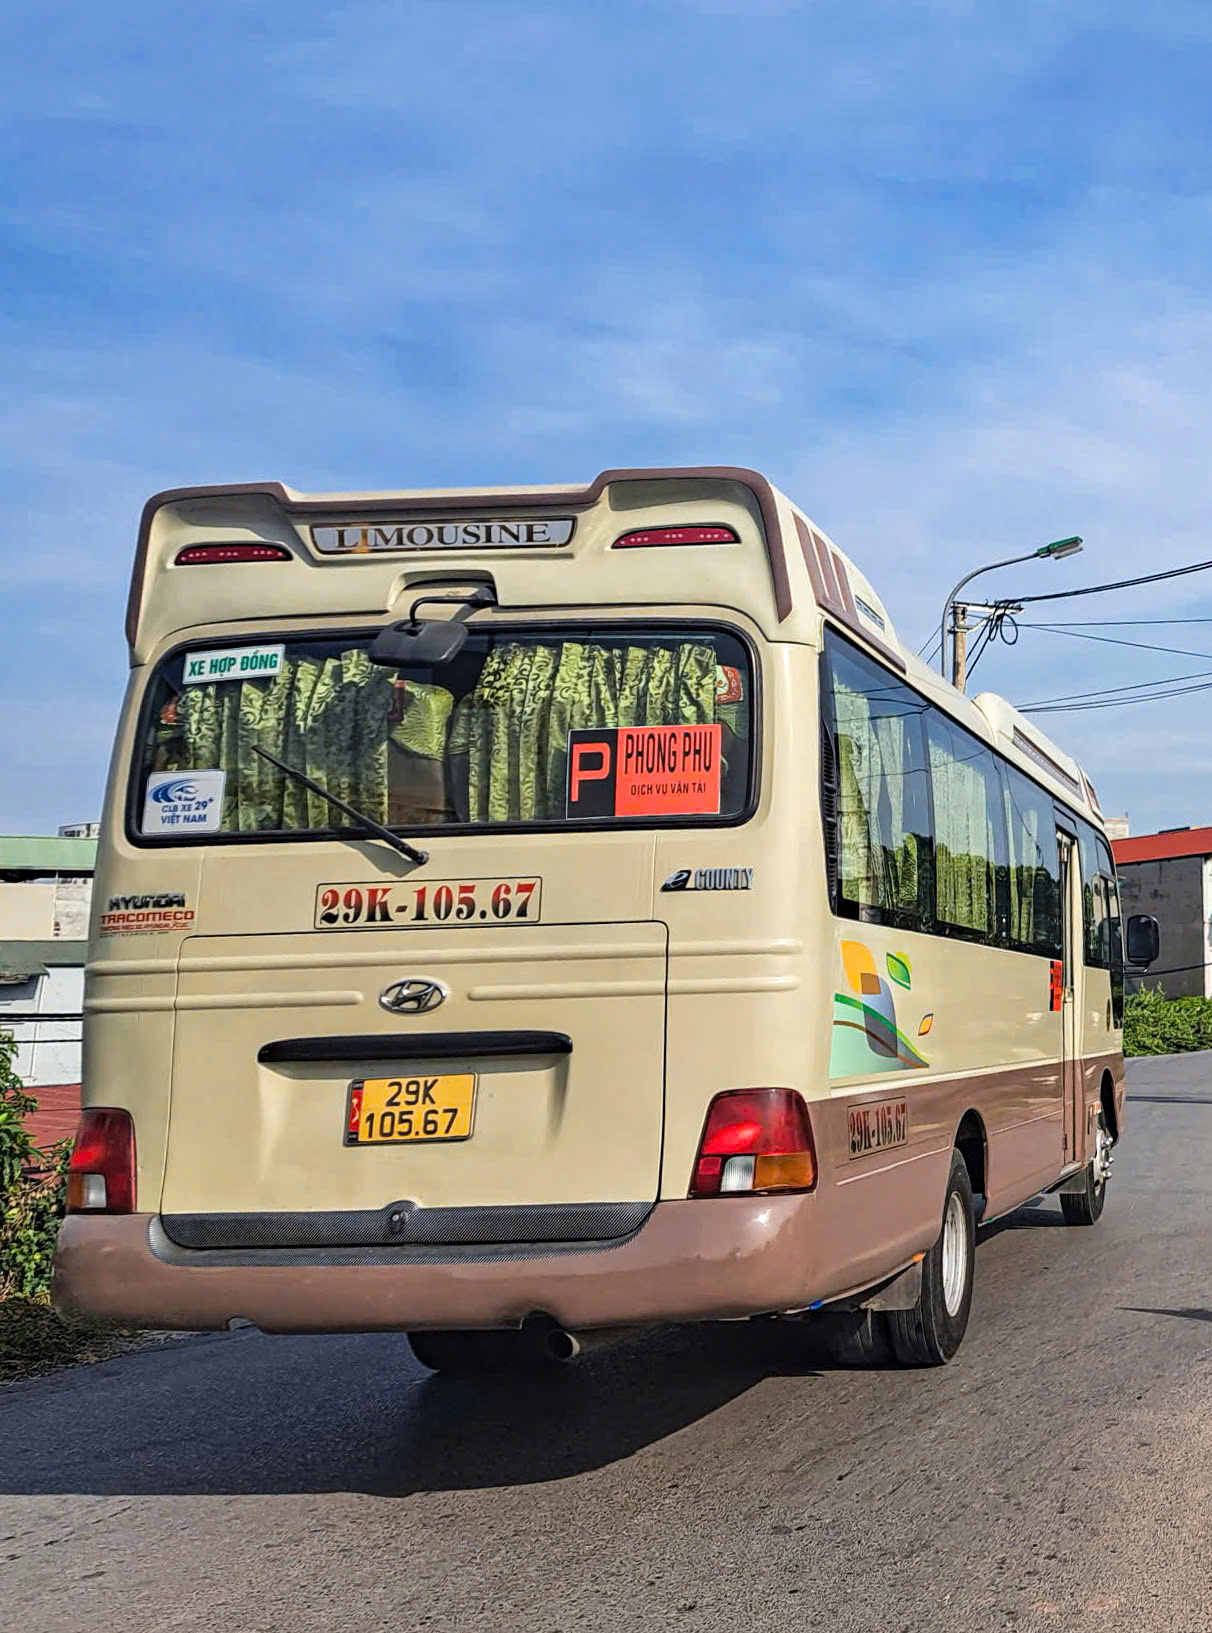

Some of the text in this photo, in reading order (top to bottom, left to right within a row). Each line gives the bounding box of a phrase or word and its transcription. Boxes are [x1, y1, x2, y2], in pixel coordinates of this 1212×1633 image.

[336, 523, 551, 548] LIMOUSINE
[188, 660, 206, 676] XE
[209, 656, 236, 676] HỢP
[624, 732, 677, 774] PHONG
[571, 742, 611, 802] P
[161, 804, 178, 813] CLB
[180, 804, 193, 812] XE
[161, 813, 207, 826] VIỆT NAM
[695, 867, 754, 890] COUNTY
[320, 882, 536, 925] 29K-105.67
[100, 910, 195, 924] TRACOMECO
[386, 1079, 438, 1107] 29K
[365, 1108, 458, 1138] 105.67
[850, 1103, 906, 1154] 29K-105.67
